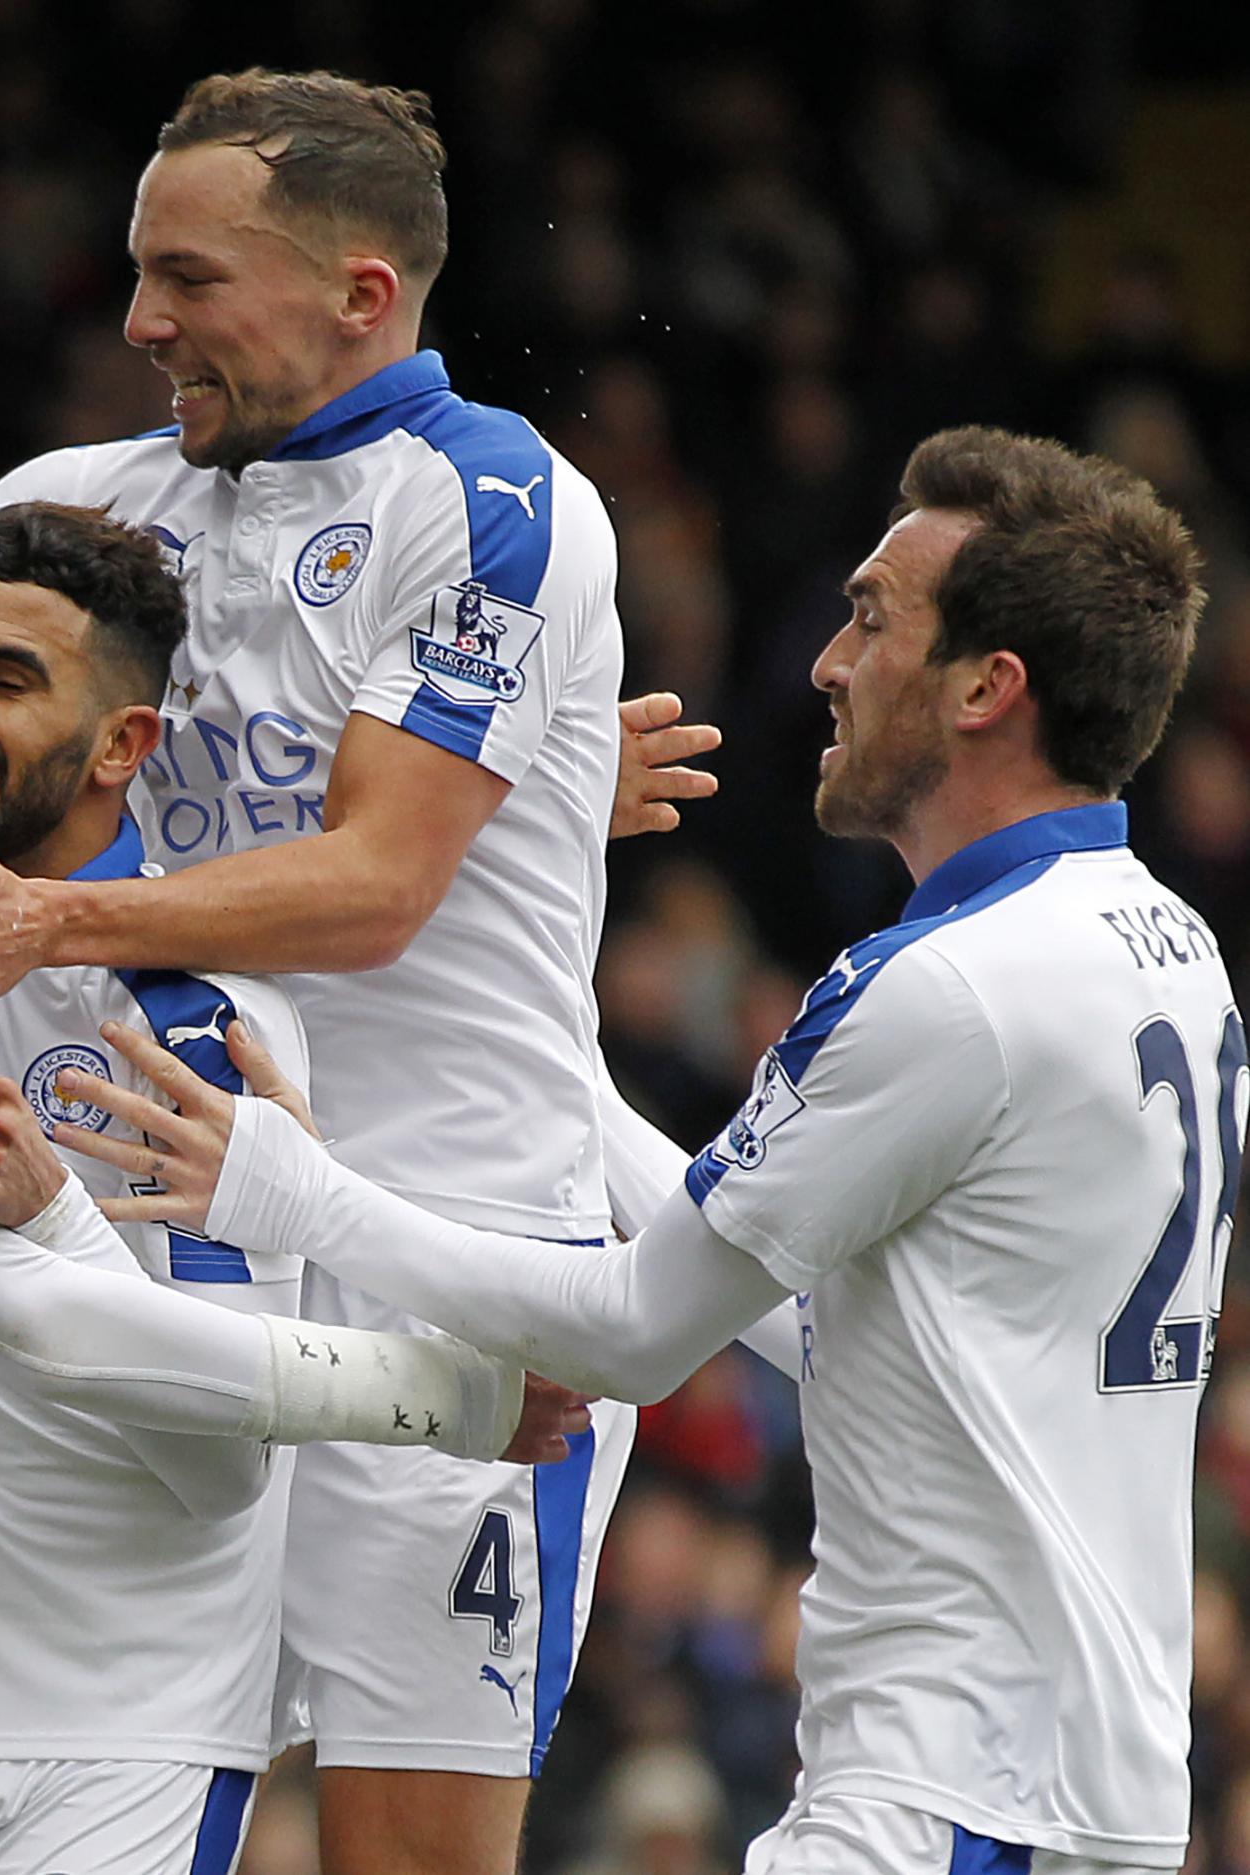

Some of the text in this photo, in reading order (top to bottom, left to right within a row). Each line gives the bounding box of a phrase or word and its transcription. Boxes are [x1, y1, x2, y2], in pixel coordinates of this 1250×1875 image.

[424, 644, 497, 679] BARCLAYS
[1098, 899, 1216, 969] FUCH
[32, 1051, 98, 1083] LEICESTER
[448, 1504, 525, 1657] 4
